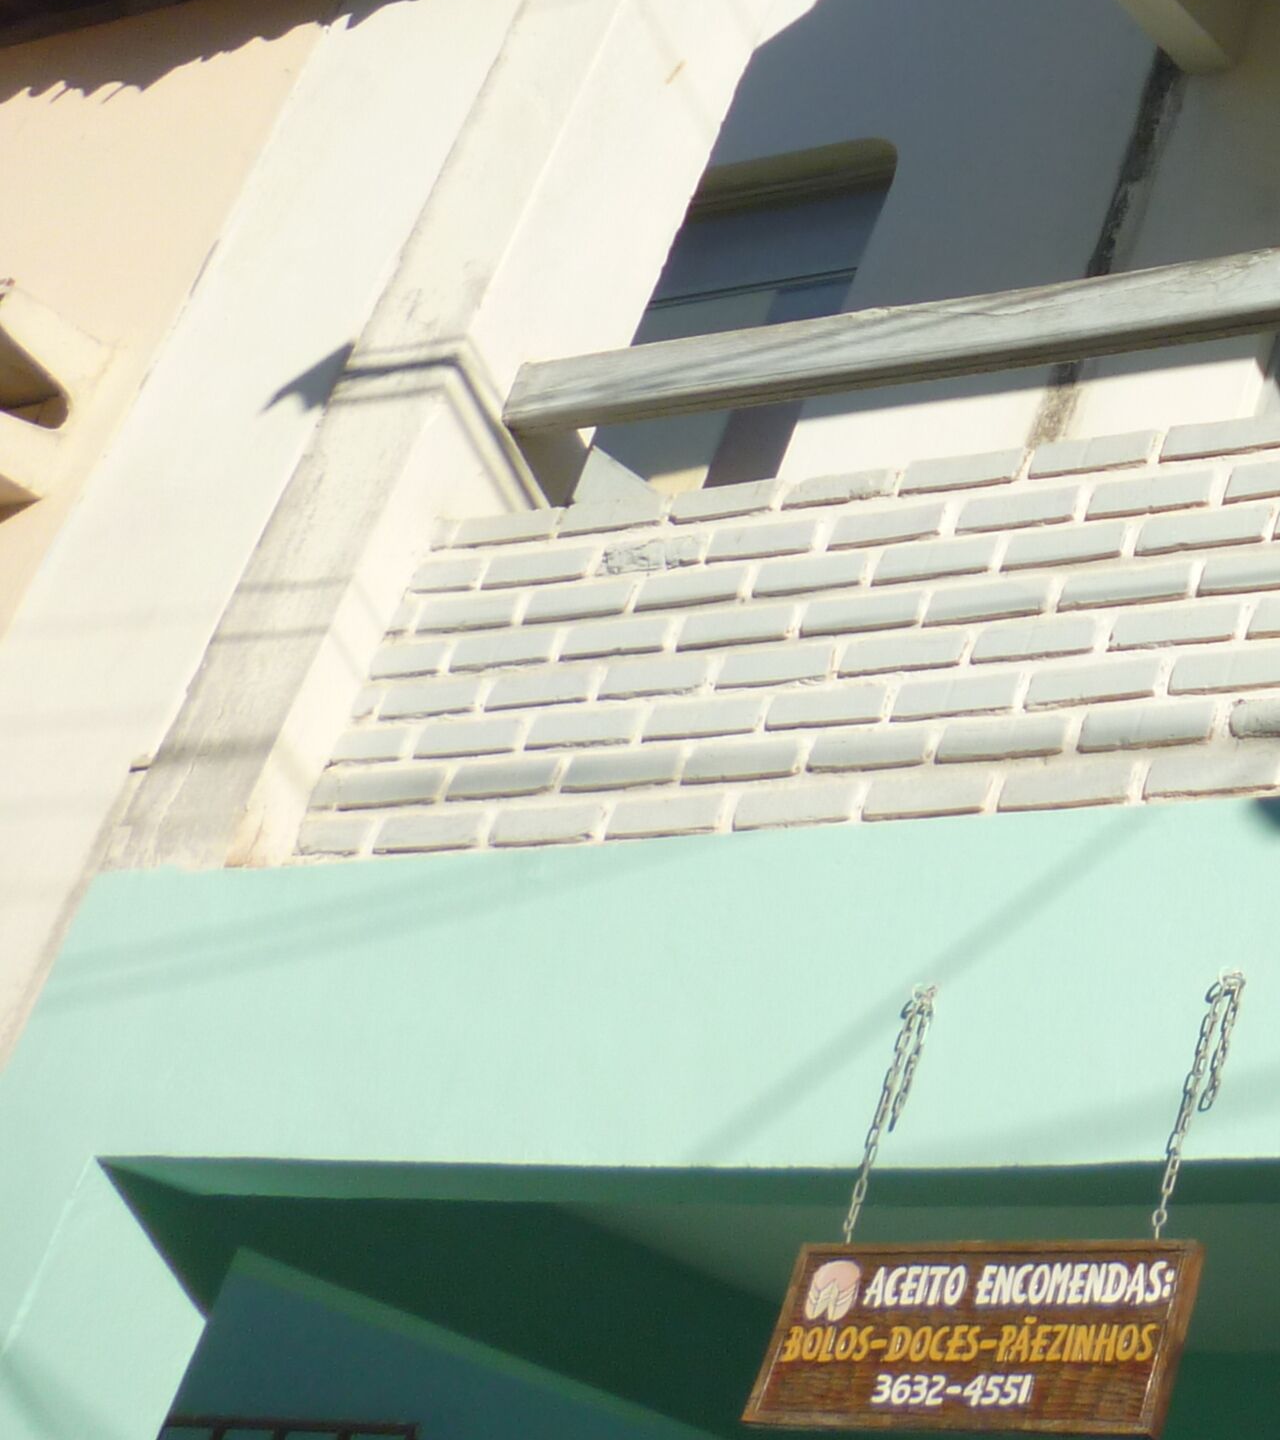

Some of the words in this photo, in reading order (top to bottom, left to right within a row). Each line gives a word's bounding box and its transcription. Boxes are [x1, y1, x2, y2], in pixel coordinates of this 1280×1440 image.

[862, 1264, 967, 1308] ACEITO
[975, 1260, 1175, 1305] ENCOMENDAS:
[870, 1373, 1033, 1408] 3632-4551
